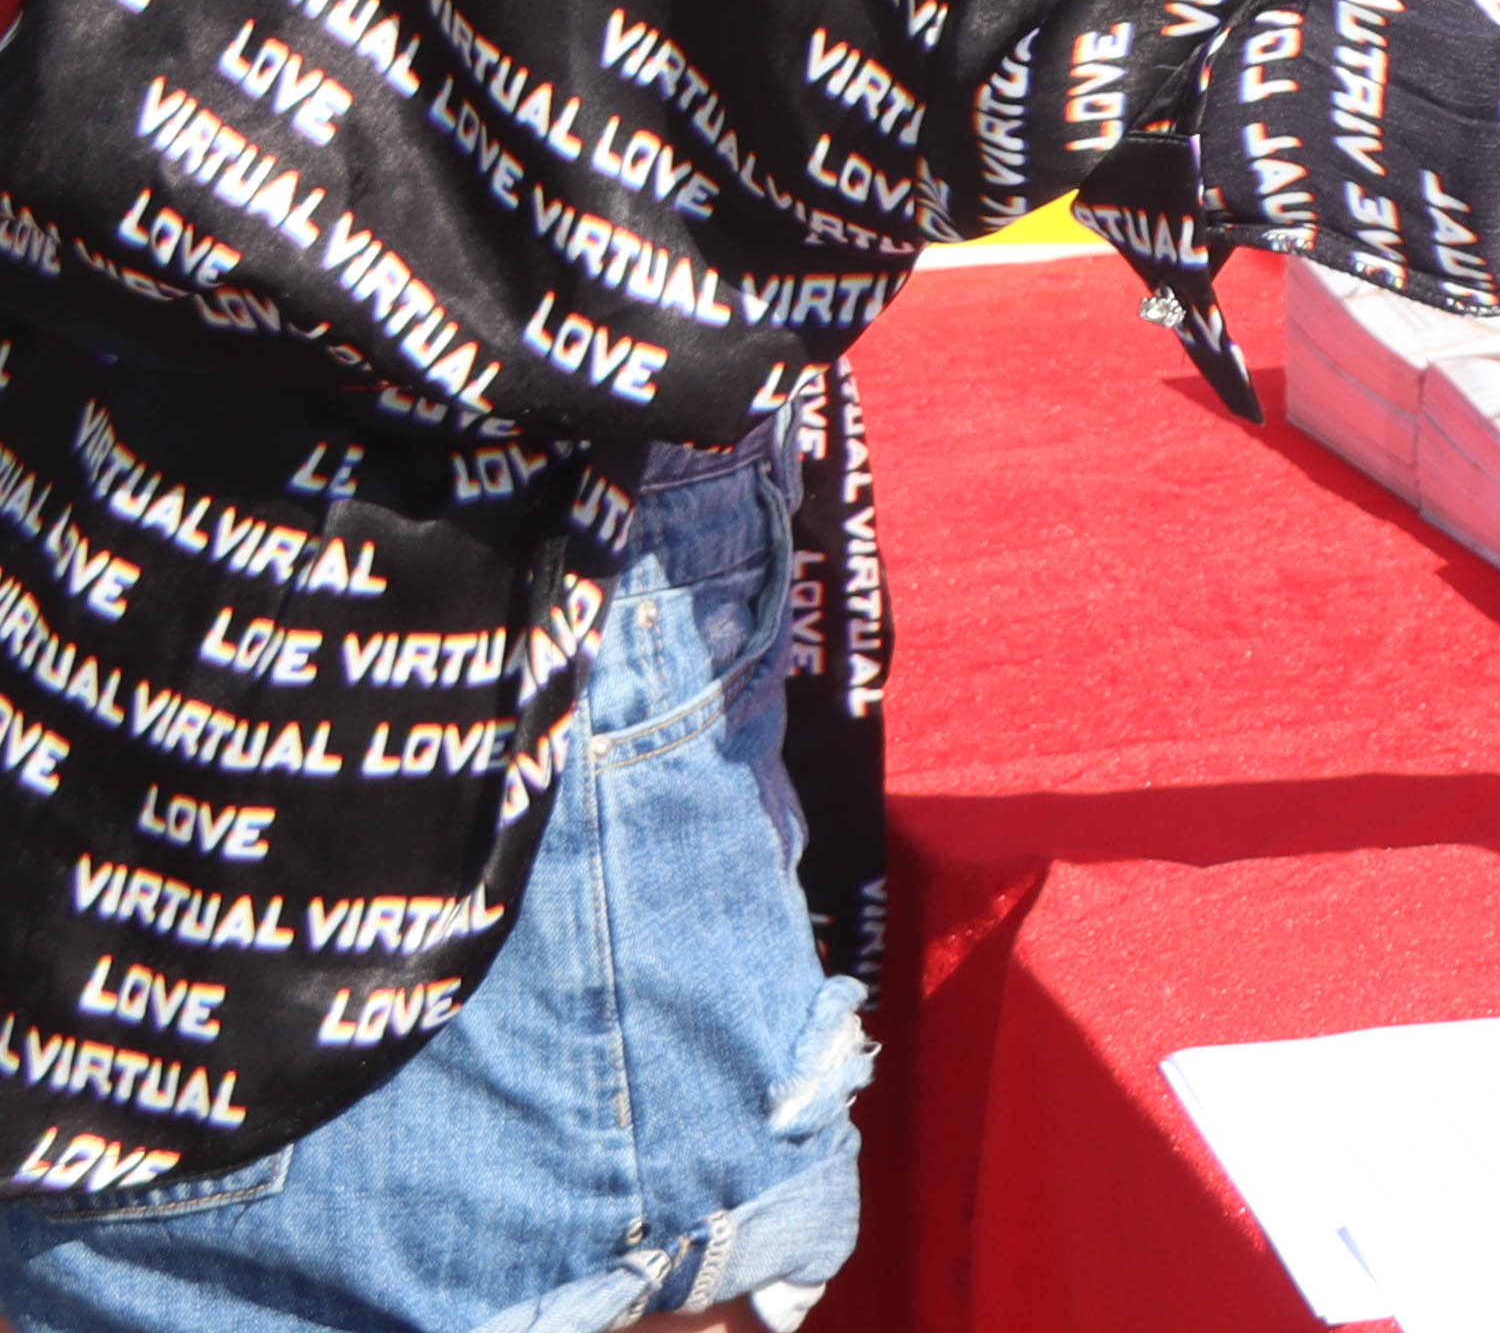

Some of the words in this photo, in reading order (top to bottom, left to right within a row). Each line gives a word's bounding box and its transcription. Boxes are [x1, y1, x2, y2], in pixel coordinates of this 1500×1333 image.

[217, 17, 355, 146] LOVE
[429, 73, 525, 211] LOVE
[599, 7, 766, 199] VIRTUAL
[1064, 21, 1134, 151] LOVE
[138, 74, 328, 252] VIRTUAL
[591, 114, 721, 221] LOVE
[807, 132, 914, 216] LOV
[117, 188, 243, 290] LOVE
[532, 182, 732, 328] VIRTUAL
[322, 211, 503, 415] VIRTUAL
[522, 289, 669, 406] LOVE
[74, 397, 211, 554] VIRTUAL
[789, 549, 829, 678] LOVE
[842, 504, 885, 720] VIRTUAL
[131, 679, 344, 777] VIRTUAL
[139, 782, 277, 861] LOVE
[74, 852, 297, 952] VIRTUAL
[79, 954, 228, 1043] LOVE
[317, 976, 465, 1047] LOVE
[24, 1025, 248, 1129] VIRTUAL
